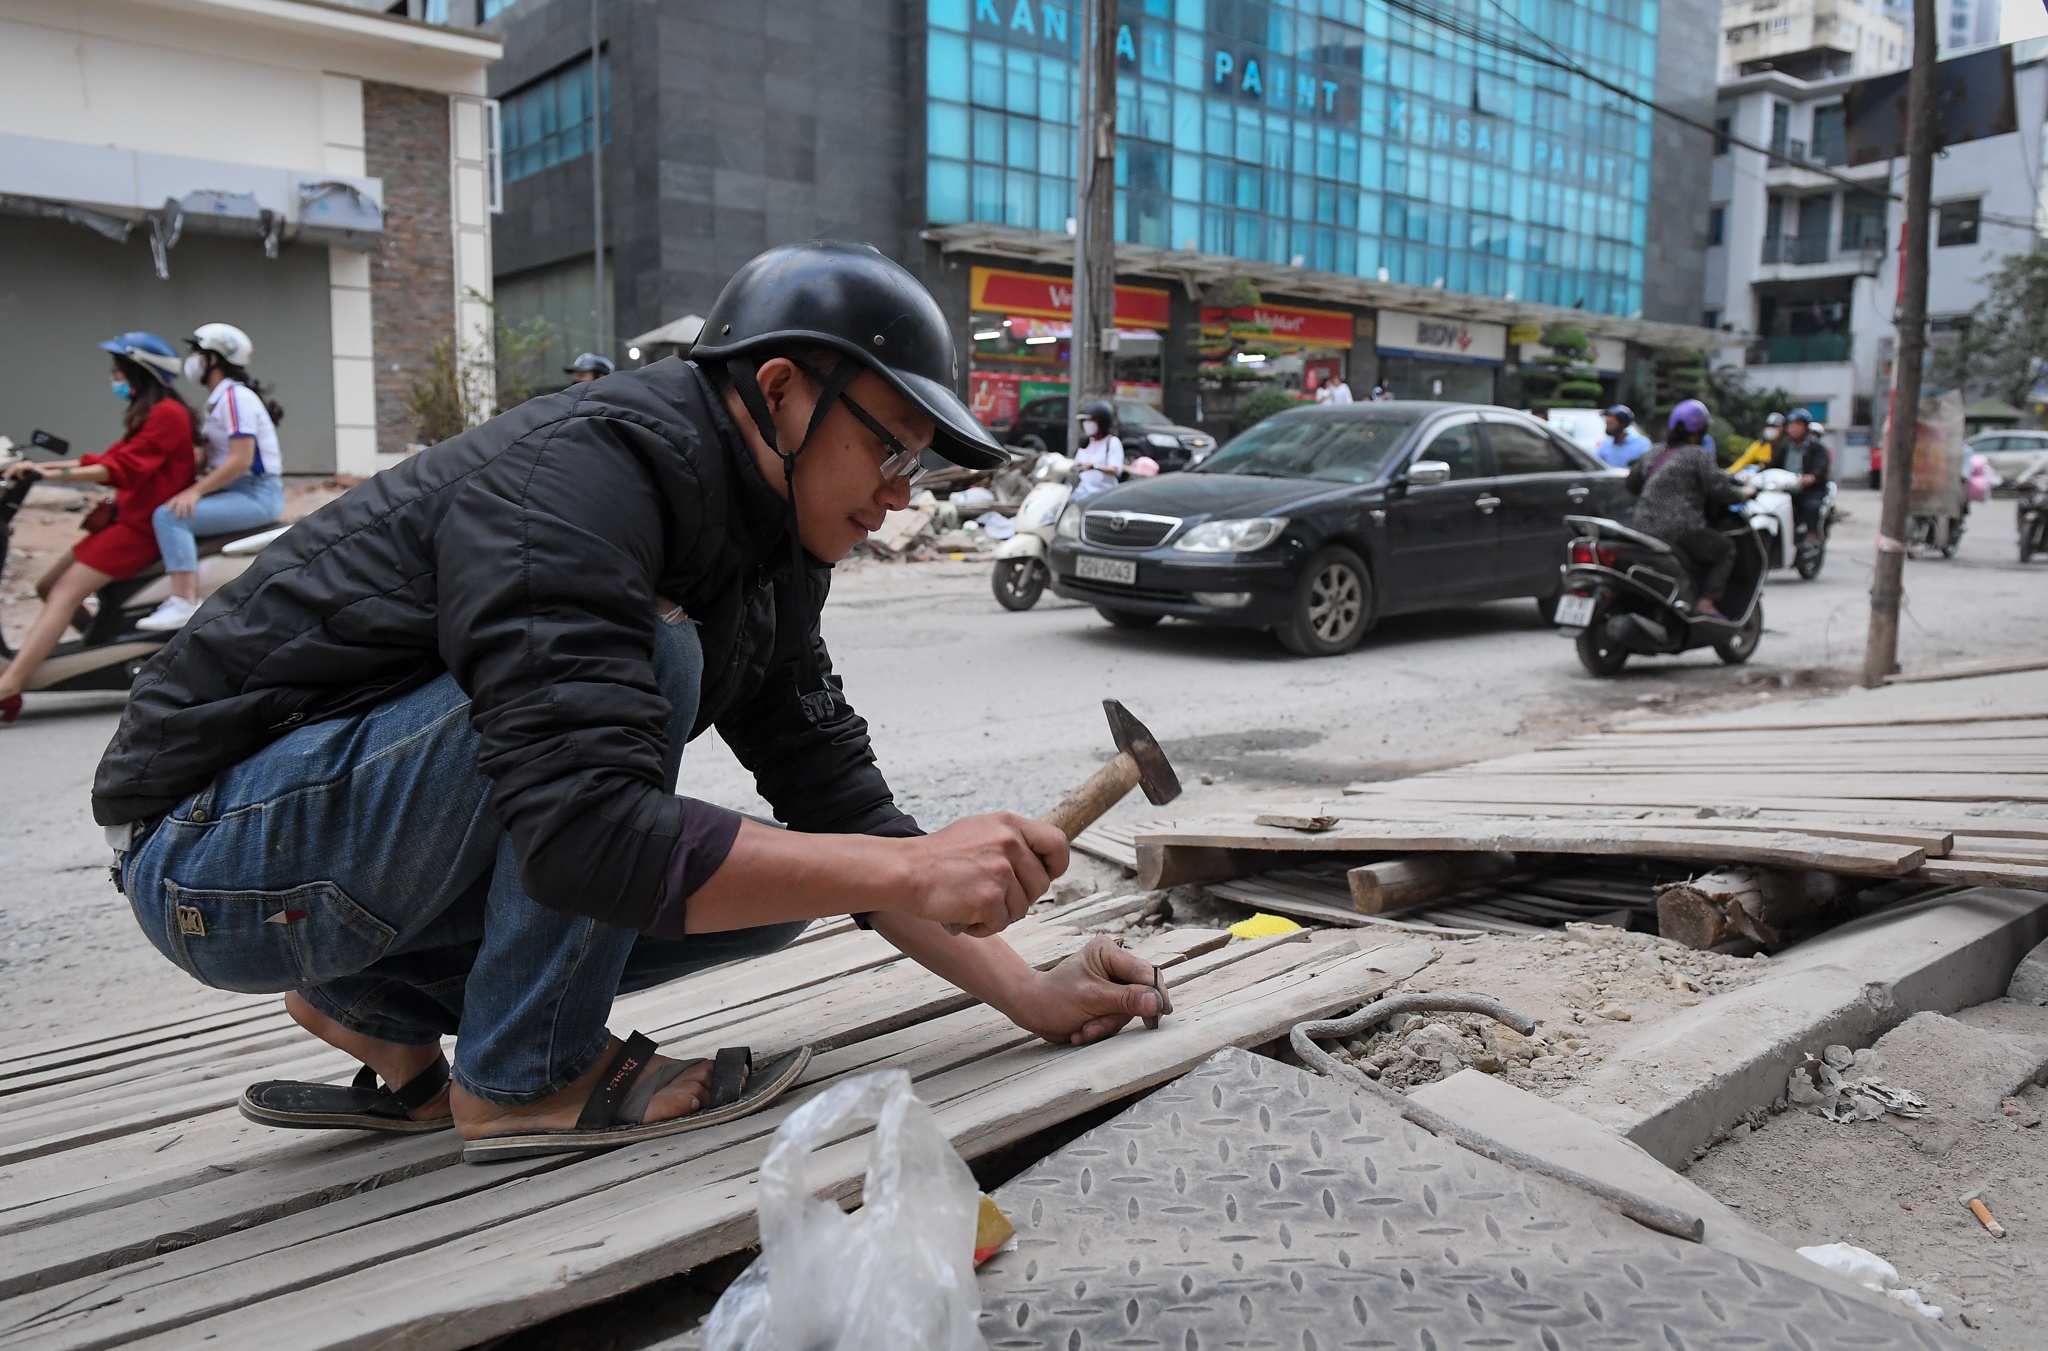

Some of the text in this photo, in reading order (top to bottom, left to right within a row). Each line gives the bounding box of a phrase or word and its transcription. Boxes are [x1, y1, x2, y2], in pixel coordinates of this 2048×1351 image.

[976, 0, 1338, 113] KANAI PAINT
[1389, 99, 1616, 183] KANSAI PAINT
[1417, 321, 1458, 347] BIDV
